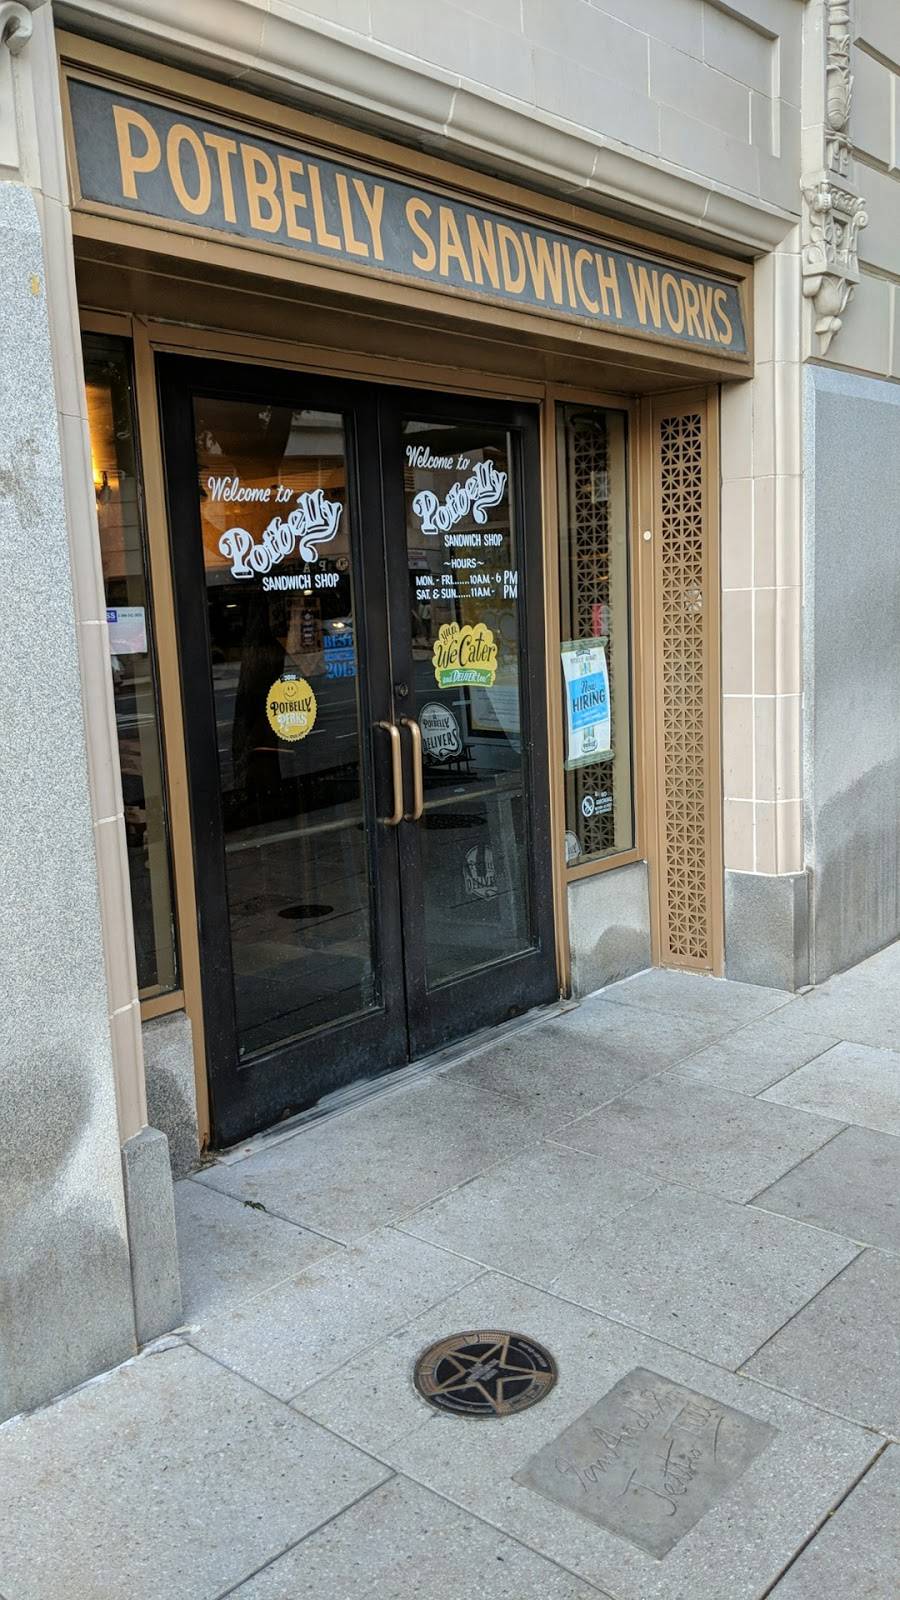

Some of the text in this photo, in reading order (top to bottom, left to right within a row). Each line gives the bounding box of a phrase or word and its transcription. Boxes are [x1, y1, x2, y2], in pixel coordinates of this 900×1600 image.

[112, 105, 734, 345] POTBELLY SANDWICH WORKS
[406, 445, 471, 470] Welcome to
[207, 476, 293, 502] Welcome to
[412, 459, 508, 535] Potbelly
[218, 489, 343, 579] Potbelly
[444, 533, 503, 548] SANDWICH SHOP
[262, 573, 339, 591] SANDWICH SHOP
[495, 572, 502, 583] 6
[503, 570, 518, 585] PM
[432, 589, 441, 599] &
[503, 585, 518, 599] PM
[437, 631, 496, 669] We Cater
[269, 697, 312, 717] POTBELLY
[572, 688, 606, 713] HIRING
[423, 716, 451, 729] POTBELLY
[423, 728, 458, 753] DELIVERS
